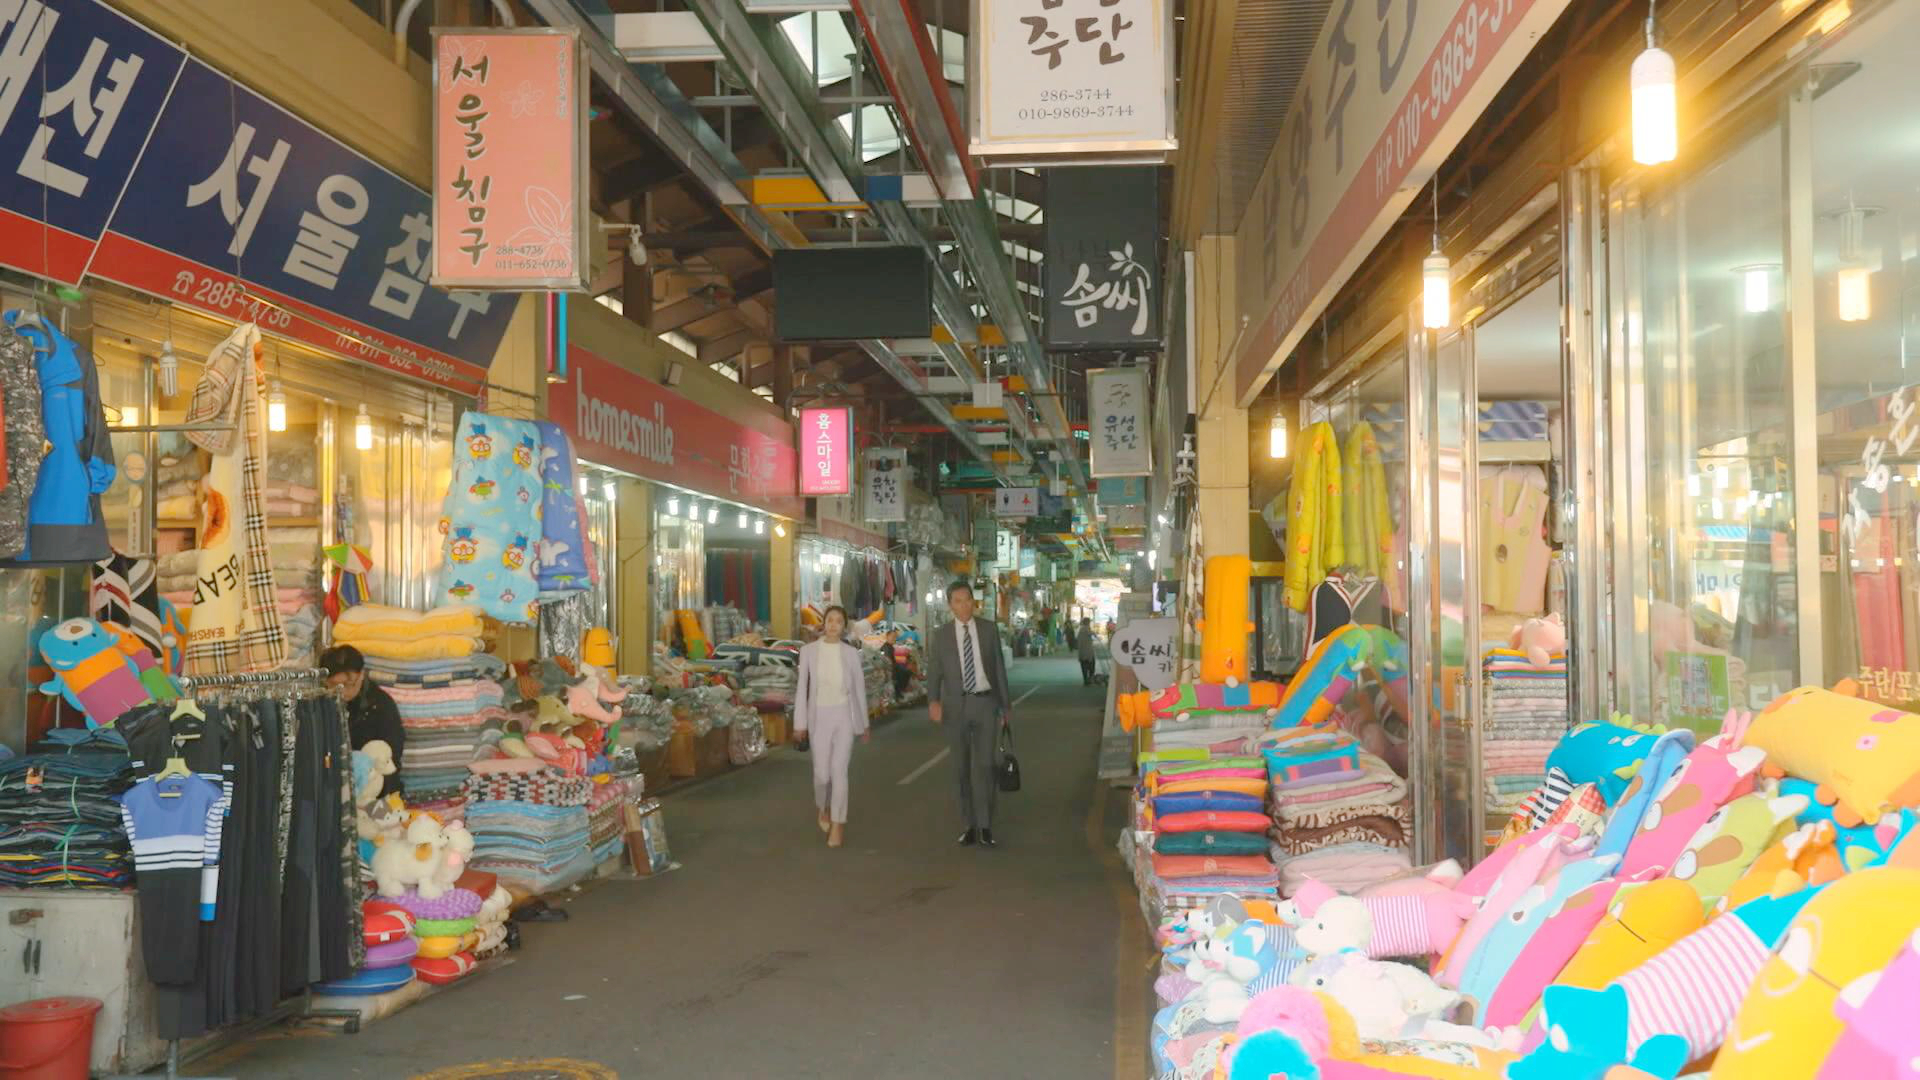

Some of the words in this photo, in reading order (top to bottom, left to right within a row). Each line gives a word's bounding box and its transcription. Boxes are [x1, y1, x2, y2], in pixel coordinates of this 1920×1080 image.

[1019, 12, 1133, 70] 주단
[1040, 88, 1112, 102] 286-3744
[1018, 104, 1134, 120] 010-9869-3744
[450, 55, 490, 266] 서울침구
[495, 245, 544, 256] 288-4736
[495, 259, 567, 270] 011-652-0736
[1060, 260, 1150, 336] 솜씨
[576, 367, 674, 465] homesmile
[1104, 415, 1135, 432] 유성
[815, 412, 832, 477] 홈스마일
[1104, 434, 1138, 450] 주단
[1130, 637, 1172, 665] 솜씨
